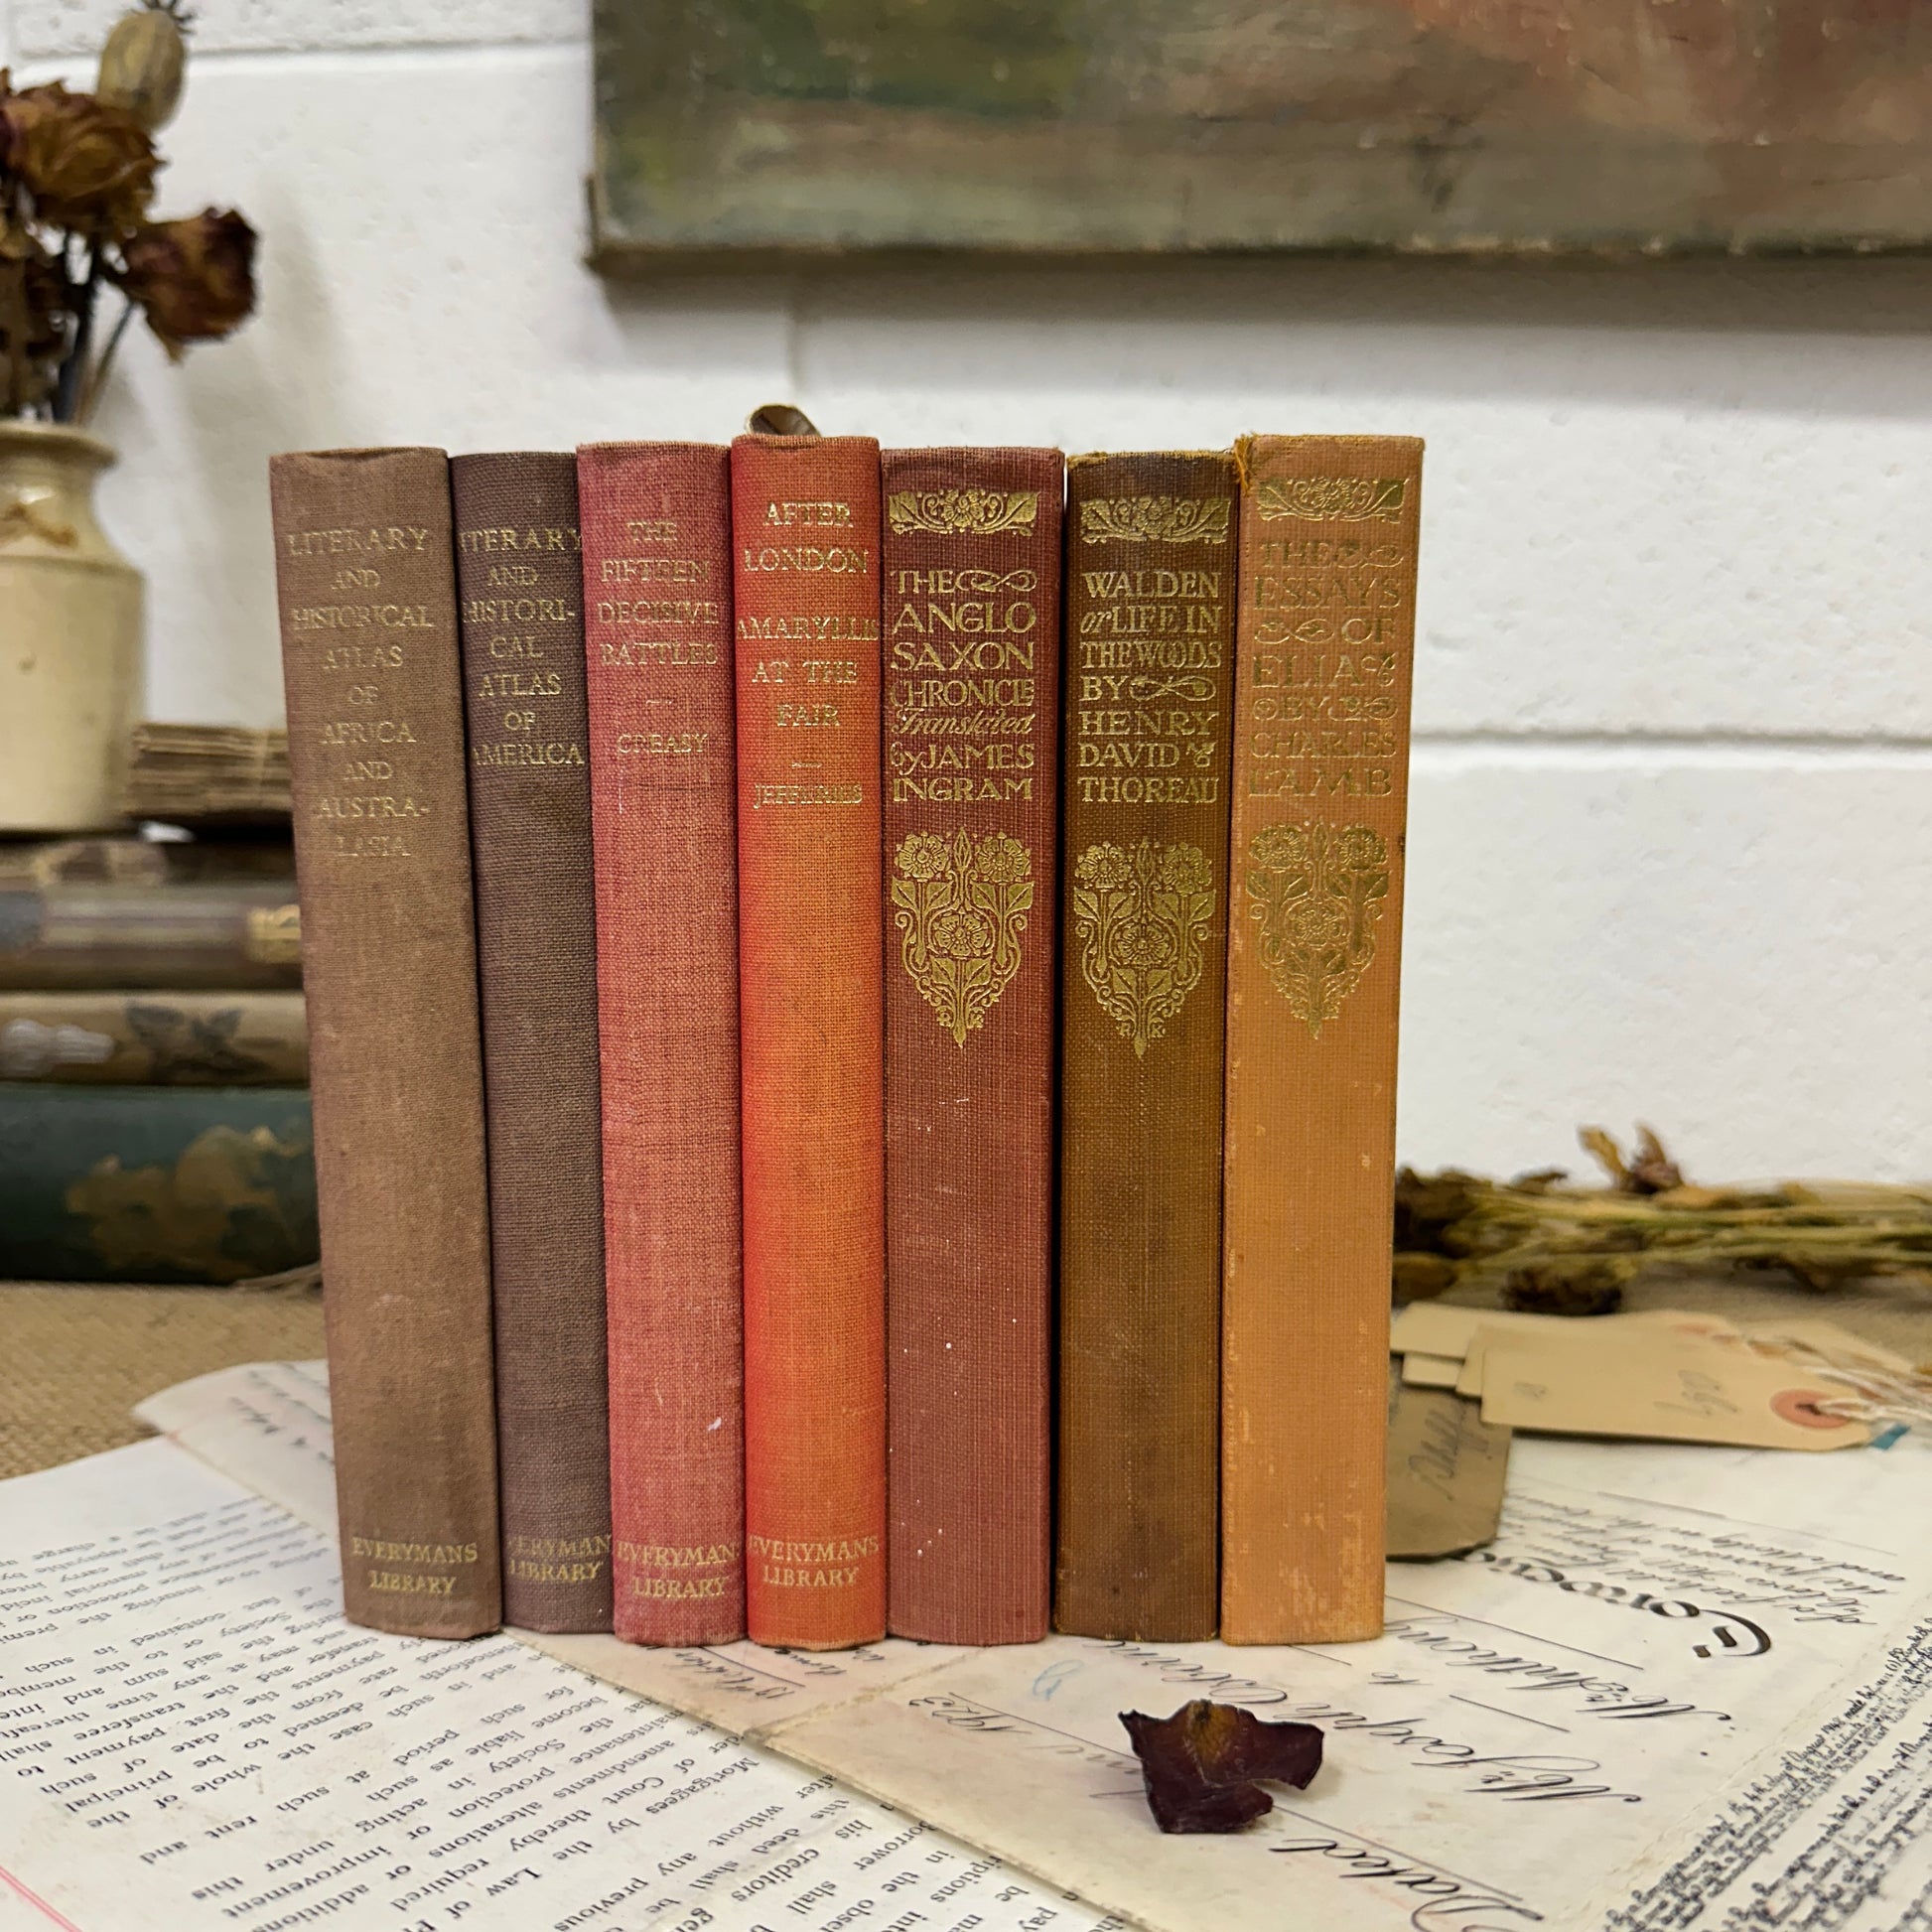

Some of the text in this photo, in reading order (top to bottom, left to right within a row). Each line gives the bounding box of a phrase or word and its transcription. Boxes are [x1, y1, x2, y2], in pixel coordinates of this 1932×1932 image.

[763, 502, 853, 527] AFTER
[288, 528, 428, 555] LITERARY
[458, 527, 581, 552] ITERARY
[627, 522, 677, 541] THE
[744, 548, 869, 573] LONDON
[1260, 541, 1334, 568] THE
[331, 569, 381, 590] AND
[486, 567, 539, 587] AND
[601, 560, 709, 583] FIFTEEN
[890, 570, 956, 594] THE
[1081, 571, 1222, 599] WALDEN
[1254, 576, 1400, 610] ESSAYS
[293, 606, 436, 629] HISTORICAL
[463, 600, 576, 622] HISTORI-
[597, 602, 719, 623] DECISIVE
[894, 602, 1036, 633] ANGLO
[1080, 607, 1223, 634] or LIFE IN
[737, 617, 878, 640] AMARYLLIS
[1342, 618, 1395, 644] OF
[324, 646, 404, 670] ATLAS
[490, 636, 544, 658] CAL
[600, 643, 717, 665] BATTLES
[891, 642, 1034, 670] SAXON
[1080, 641, 1222, 668] THE WOODS
[752, 661, 858, 683] AT THE
[1253, 655, 1365, 688] ELIA
[347, 686, 378, 705] OF
[479, 674, 561, 697] ATLAS
[1080, 677, 1129, 701] BY
[504, 712, 536, 730] OF
[777, 704, 840, 726] FAIR
[892, 708, 1035, 736] Translated
[1278, 698, 1330, 722] BY
[319, 722, 416, 744] AFRICA
[1078, 712, 1219, 736] HENRY
[472, 744, 585, 765] AMERICA
[617, 734, 708, 754] CREASY
[1077, 744, 1180, 767] DAVID
[1250, 732, 1396, 759] CHARLES
[344, 761, 393, 780] AND
[891, 743, 1035, 775] by JAMES
[894, 778, 1033, 801] INGRAM
[1077, 777, 1219, 802] THOREAU
[1249, 768, 1392, 796] LAMB
[318, 796, 430, 818] AUSTRA-
[352, 1537, 479, 1562] EVERYMANS
[616, 1541, 740, 1568] EVERYMAN
[750, 1536, 879, 1562] EVERYMANS
[368, 1571, 457, 1594] LIBRARY
[509, 1561, 603, 1582] LIBRARY
[761, 1567, 860, 1587] LIBRARY
[632, 1577, 728, 1598] LIBRARY
[24, 1613, 226, 1673] contained such
[93, 1661, 130, 1675] the
[63, 1668, 169, 1706] sum and
[105, 1674, 211, 1710] any time
[0, 1666, 294, 1762] and the transferee shall
[17, 1650, 385, 1777] payments the first payment to
[40, 1666, 398, 1795] rate from the date of such
[64, 1702, 364, 1813] deemed to be principal
[86, 1695, 435, 1828] such case the whole of the
[365, 1696, 609, 1802] become liable as such
[553, 1740, 675, 1799] amendments
[139, 1704, 526, 1864] such period at such rent and
[448, 1766, 556, 1818] protection
[192, 1718, 614, 1900] the Society in acting under this
[390, 1758, 695, 1912] of Court thereby required
[406, 1826, 432, 1841] or
[428, 1801, 543, 1858] alterations
[444, 1757, 759, 1920] Mortgagees by the Law of
[708, 1806, 784, 1847] without
[644, 1800, 850, 1914] this deed shall be
[657, 1853, 697, 1876] any
[731, 1819, 873, 1902] his creditors
[221, 1846, 392, 1918] improvement
[385, 1864, 412, 1880] or
[881, 1851, 955, 1892] in the
[553, 1877, 649, 1932] previous
[785, 1880, 837, 1915] shall
